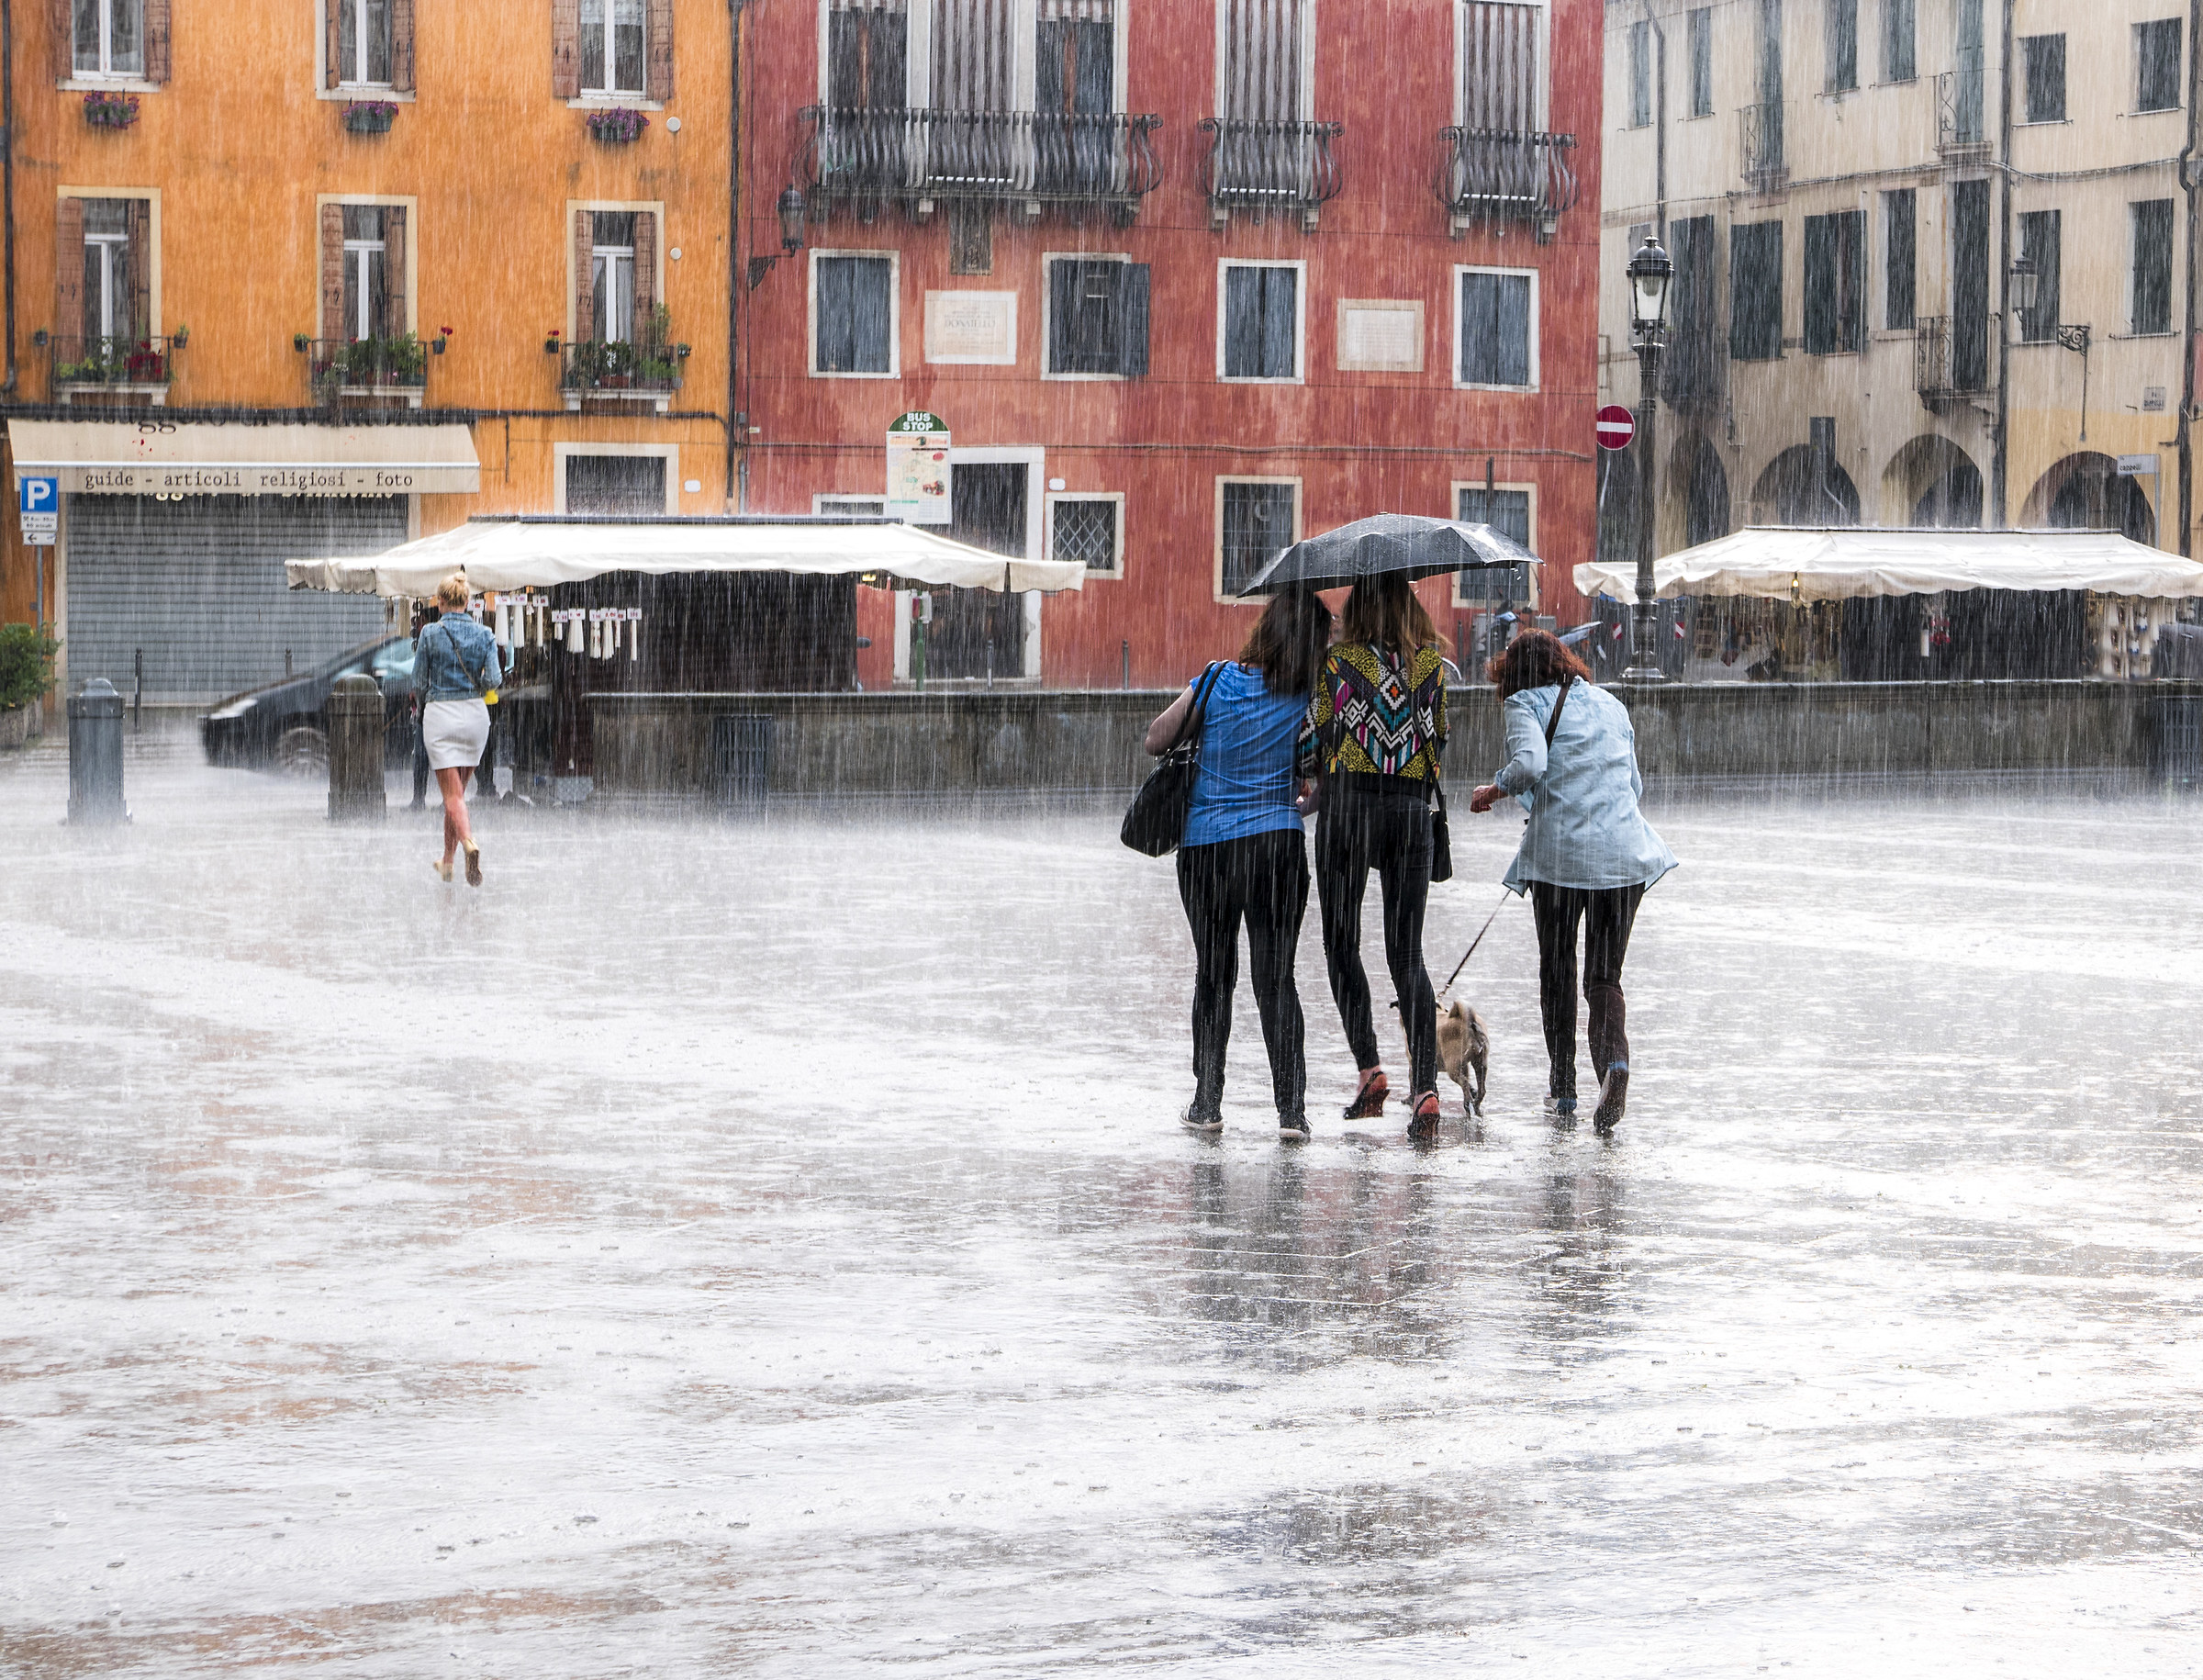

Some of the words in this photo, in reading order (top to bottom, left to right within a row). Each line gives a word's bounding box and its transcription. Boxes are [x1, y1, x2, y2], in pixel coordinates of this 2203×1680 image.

[907, 412, 931, 422] BUS
[902, 422, 934, 431] STOP
[85, 471, 134, 489] guide
[164, 471, 242, 487] articoli
[260, 471, 346, 490] religiosi
[375, 471, 413, 487] foto
[28, 480, 50, 510] P
